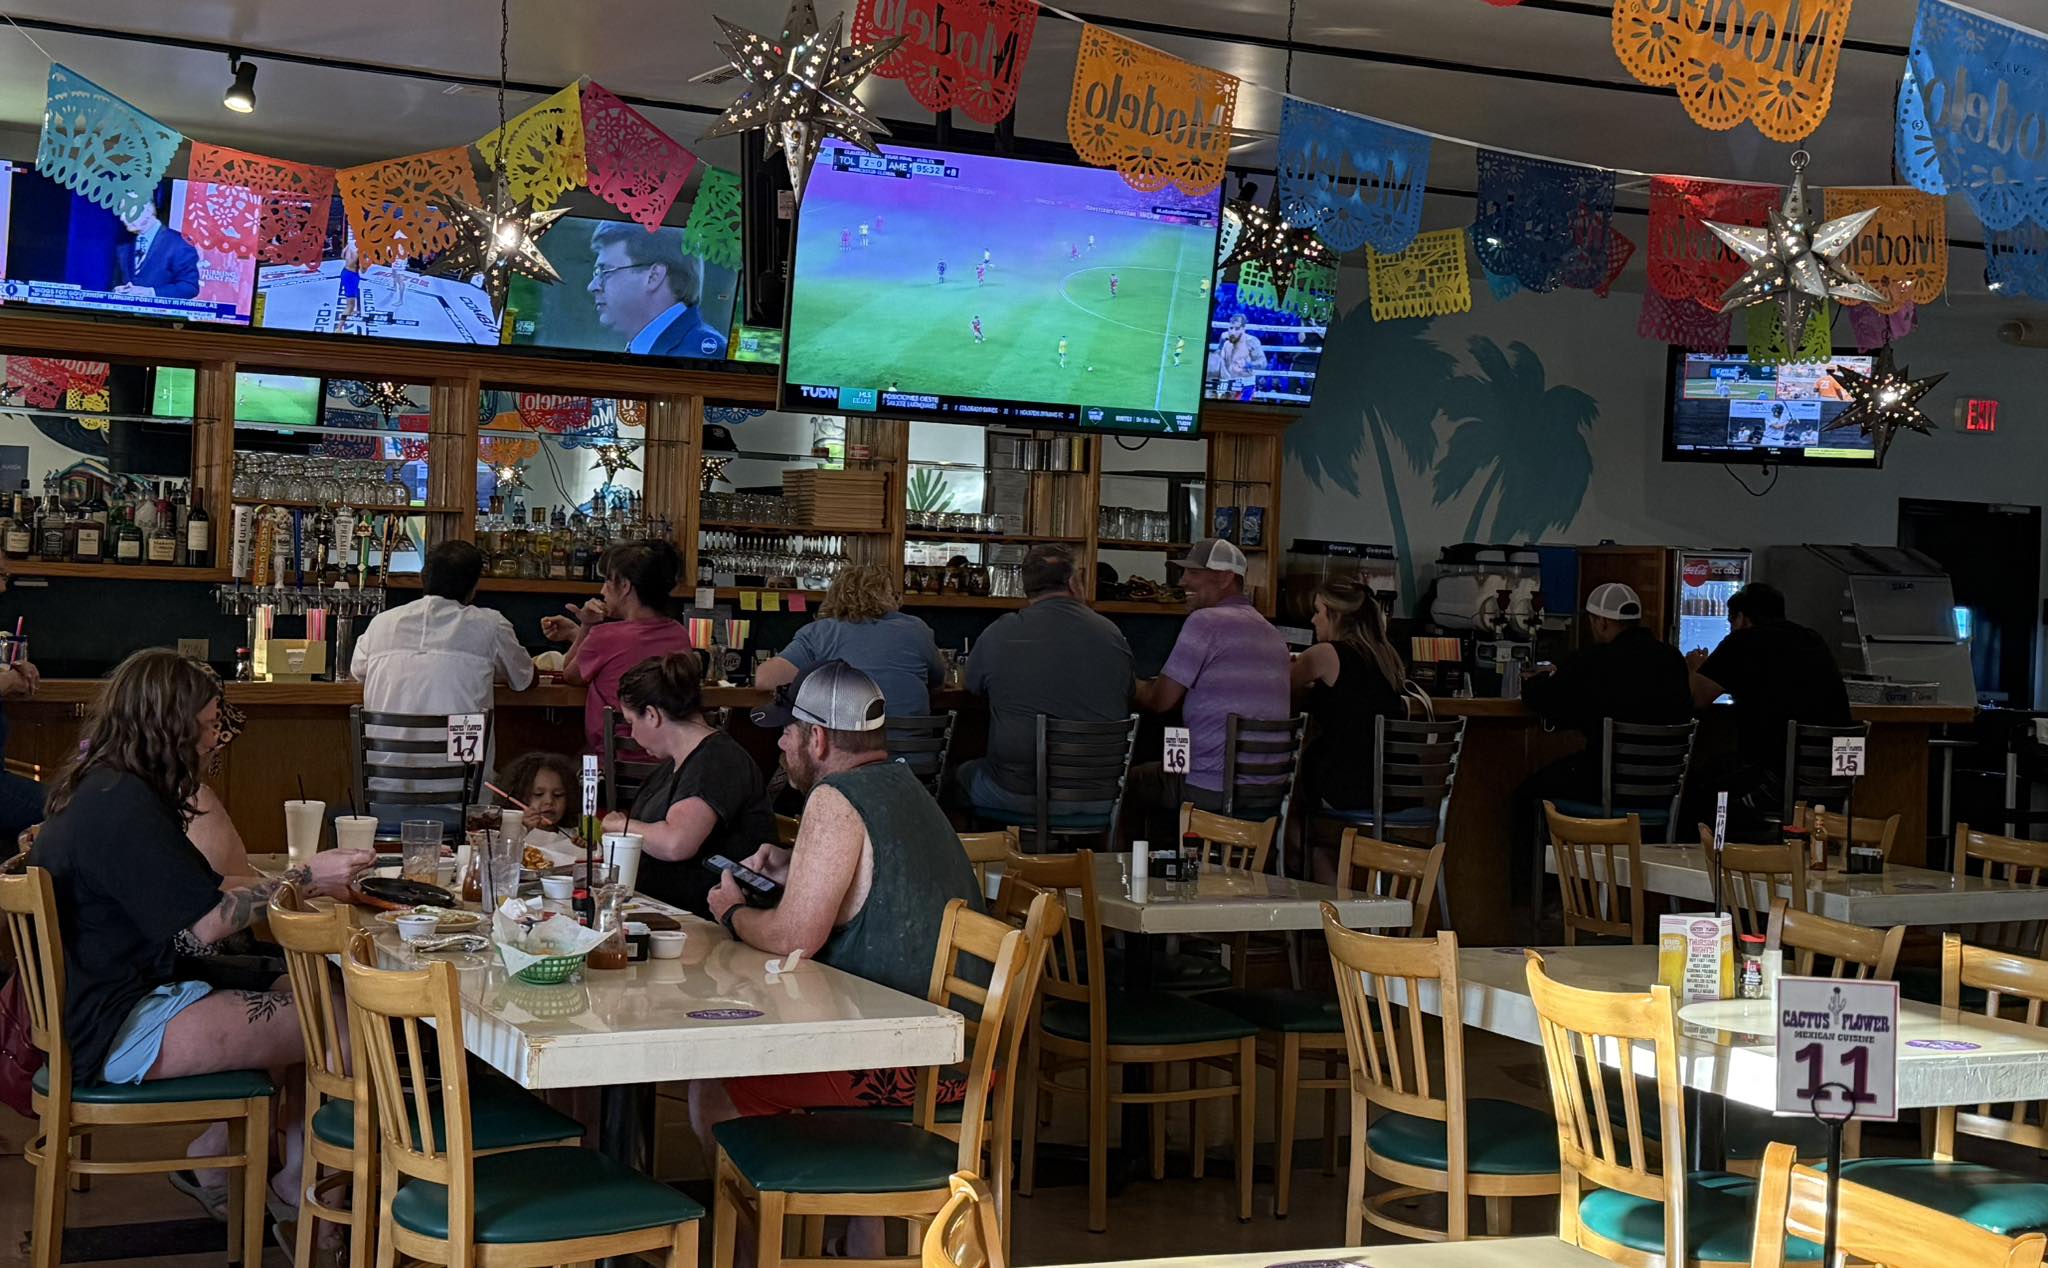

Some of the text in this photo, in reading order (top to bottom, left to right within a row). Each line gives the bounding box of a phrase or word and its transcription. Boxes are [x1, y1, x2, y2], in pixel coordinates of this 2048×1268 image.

[840, 156, 856, 166] TOL
[889, 162, 908, 171] AME
[801, 386, 837, 399] TUDN
[1967, 400, 1998, 431] EXIT
[240, 511, 248, 538] ULTRA
[339, 524, 348, 561] PREMIER
[453, 735, 479, 757] 17
[1167, 749, 1186, 768] 16
[1835, 754, 1858, 772] 15
[1783, 1010, 1890, 1033] CACTUS FLOWER
[1794, 1030, 1875, 1044] MEXICAN CUISINE
[1795, 1042, 1877, 1104] 11
